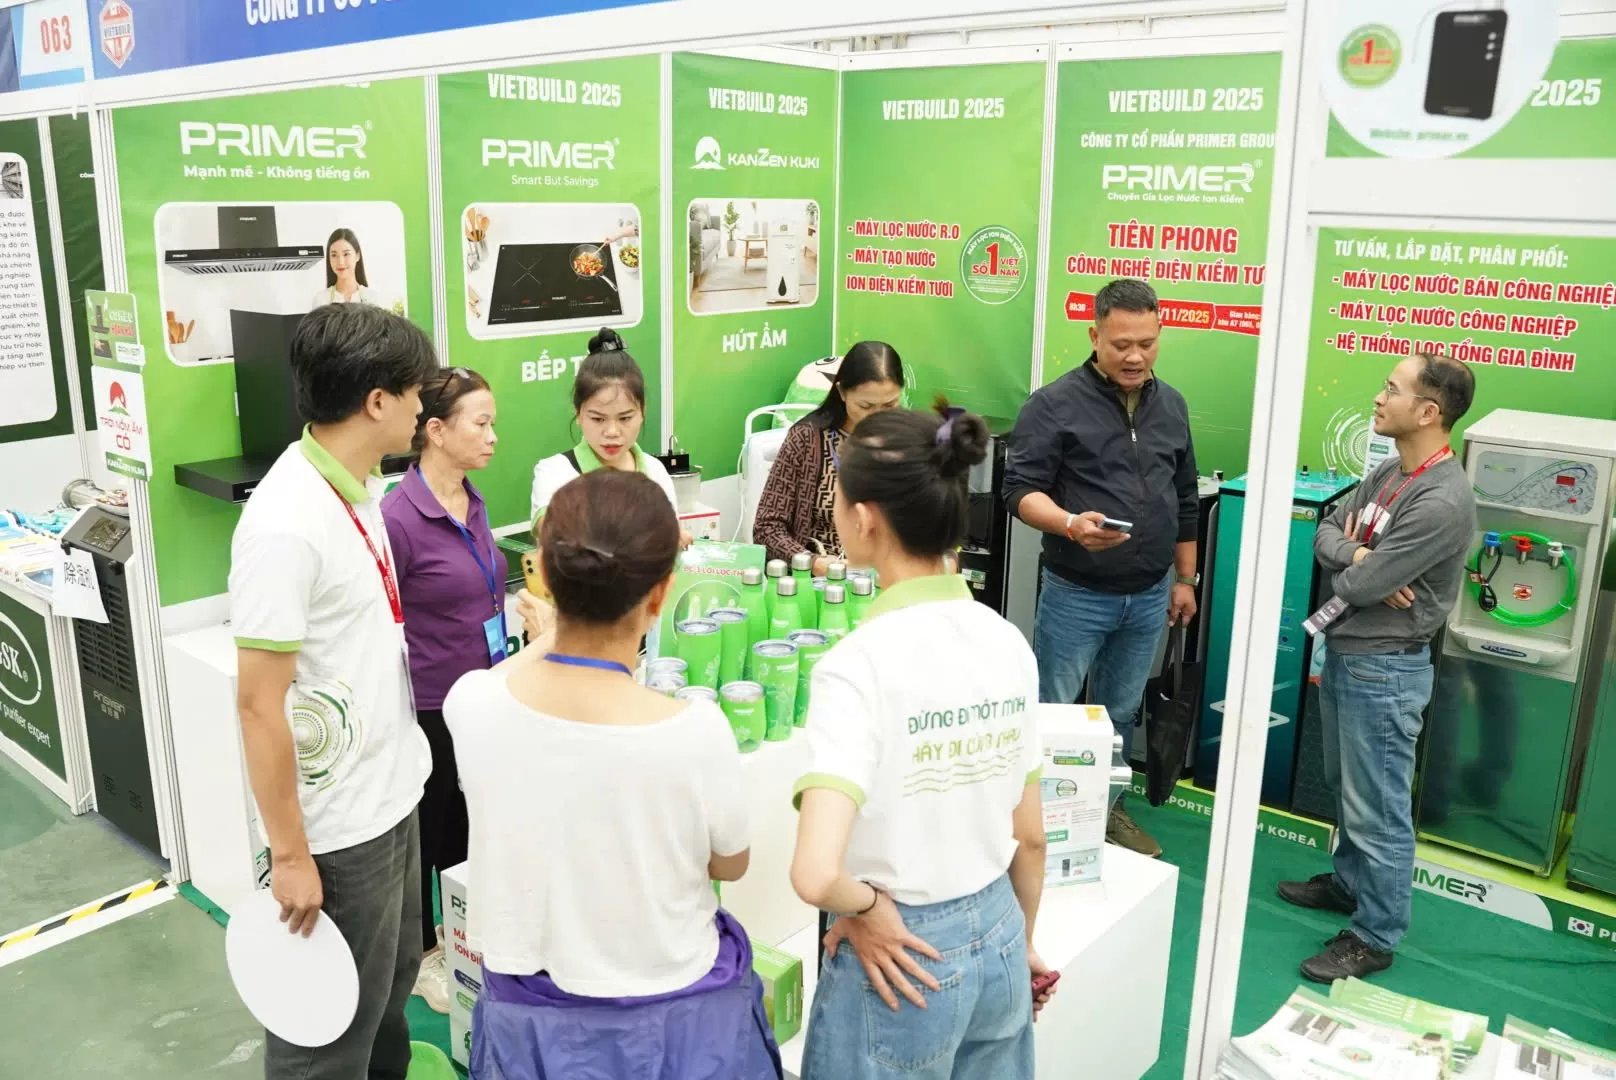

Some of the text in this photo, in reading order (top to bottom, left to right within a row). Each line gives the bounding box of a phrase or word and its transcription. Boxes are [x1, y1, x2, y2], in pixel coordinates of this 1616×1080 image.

[40, 15, 72, 54] 063
[488, 72, 622, 107] VIETBUILD 2025
[709, 87, 808, 116] VIETBUILD 2025
[1108, 87, 1264, 113] VIETBUILD 2025
[1531, 78, 1602, 107] 2025
[882, 97, 1005, 120] VIETBUILD 2025
[1080, 131, 1113, 148] CÔNG
[1115, 133, 1130, 148] TY
[1187, 133, 1237, 148] PRIMER
[183, 164, 227, 180] Mạnh
[231, 164, 254, 178] mẽ
[266, 165, 313, 181] Không
[315, 166, 350, 182] tiếng
[789, 155, 820, 169] KUKI
[511, 174, 600, 188] Smart But Savings
[1202, 194, 1218, 204] Ion
[855, 218, 960, 240] MÁY LỌC NƯỚC R.O
[1108, 219, 1239, 253] TIÊN PHONG
[855, 246, 936, 268] MÁY TẠO NƯỚC
[972, 241, 1000, 276] SỐ 1
[1000, 256, 1019, 268] VIỆT
[1334, 239, 1354, 257] TƯ
[1468, 244, 1516, 266] PHÂN
[1000, 268, 1020, 277] NAM
[1067, 253, 1107, 275] CÔNG
[1110, 256, 1151, 281] NGHỆ
[1155, 258, 1193, 284] ĐIỆN
[1243, 264, 1266, 285] TƯ
[846, 276, 866, 291] ION
[869, 274, 894, 295] ĐIỆN
[928, 280, 953, 297] TƯƠI
[1343, 269, 1378, 289] MÁY
[1381, 272, 1410, 294] LỌC
[1415, 273, 1458, 296] NƯỚC
[1463, 276, 1499, 298] BÁN
[1504, 278, 1552, 302] CÔNG
[1556, 283, 1616, 308] NGHIỆ
[1158, 306, 1210, 324] /11/2025
[1340, 301, 1374, 320] MÁY
[1377, 305, 1406, 328] LỌC
[1411, 306, 1456, 328] NƯỚC
[1460, 309, 1506, 332] CÔNG
[1510, 315, 1577, 340] NGHIỆP
[722, 328, 756, 352] HÚT
[1336, 331, 1356, 354] HỆ
[1361, 332, 1411, 356] THỐNG
[1497, 347, 1526, 368] GIA
[1531, 346, 1576, 371] ĐÌNH
[521, 349, 590, 383] BẾP T
[0, 641, 23, 679] SK
[908, 708, 955, 735] ĐỪNG
[1165, 795, 1213, 816] PORTE
[1267, 824, 1318, 848] KOREA
[454, 941, 470, 959] ION
